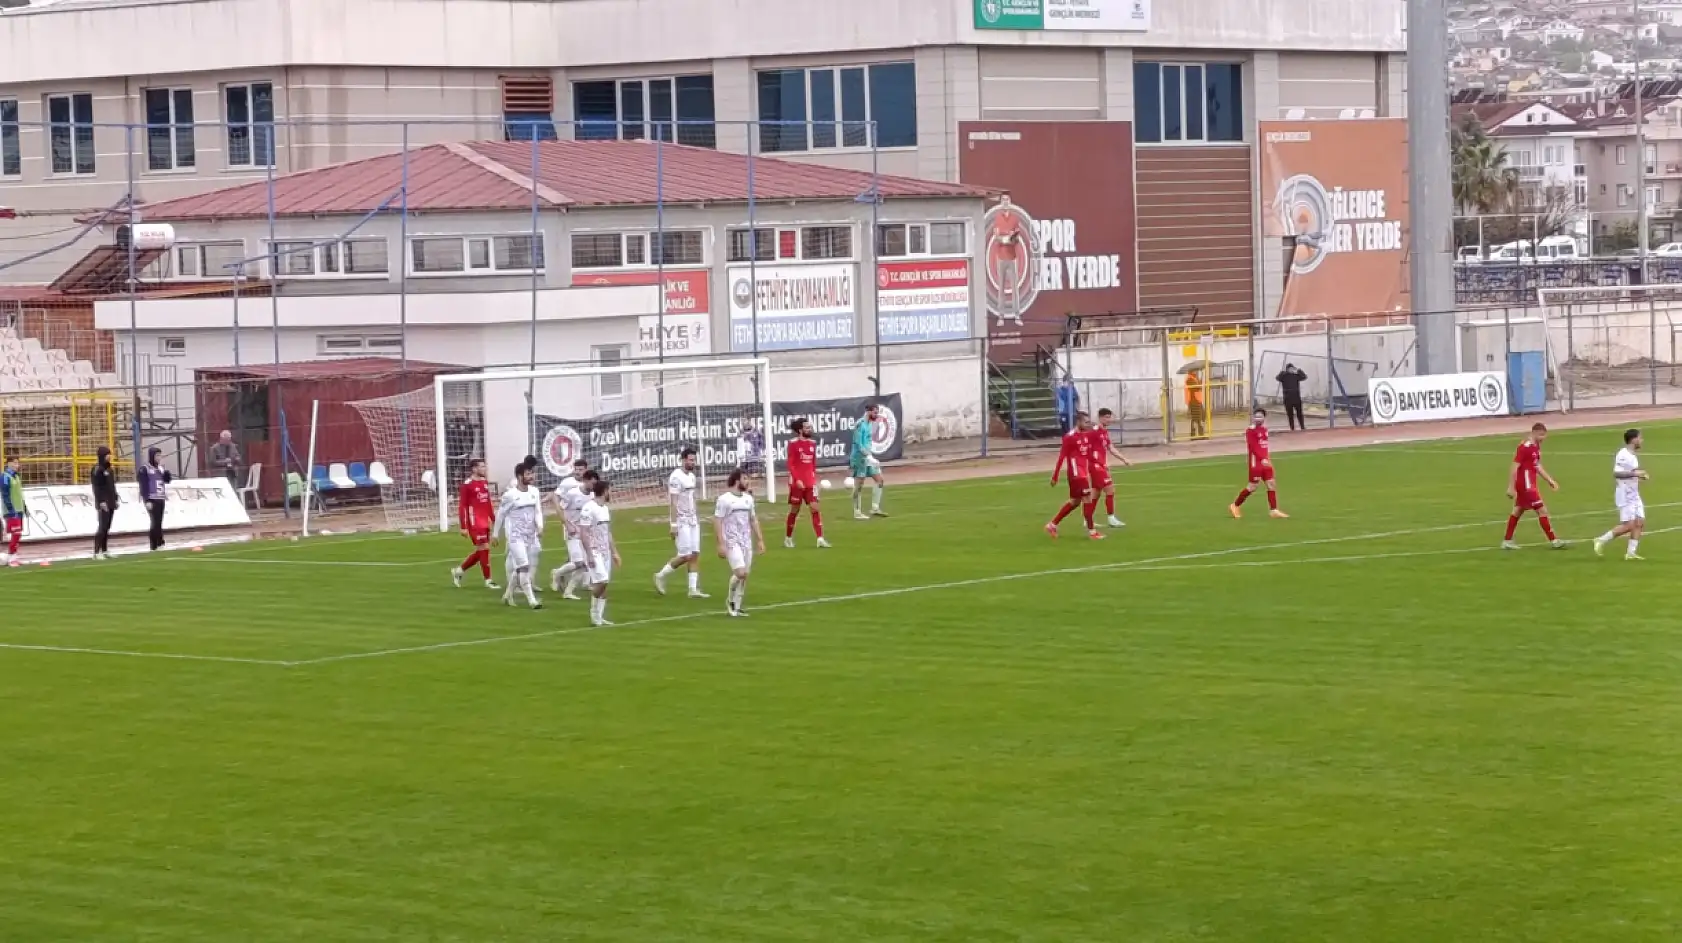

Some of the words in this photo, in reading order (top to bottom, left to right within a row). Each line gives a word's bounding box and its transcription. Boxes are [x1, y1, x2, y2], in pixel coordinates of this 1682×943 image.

[1031, 219, 1076, 253] SPOR
[1356, 220, 1402, 250] YERDE
[1065, 255, 1120, 289] YERDE
[756, 272, 788, 311] FETHİYE
[1399, 389, 1451, 411] BAVYERA
[1454, 387, 1477, 408] PUB
[623, 421, 675, 443] Lokman
[156, 480, 165, 494] 5
